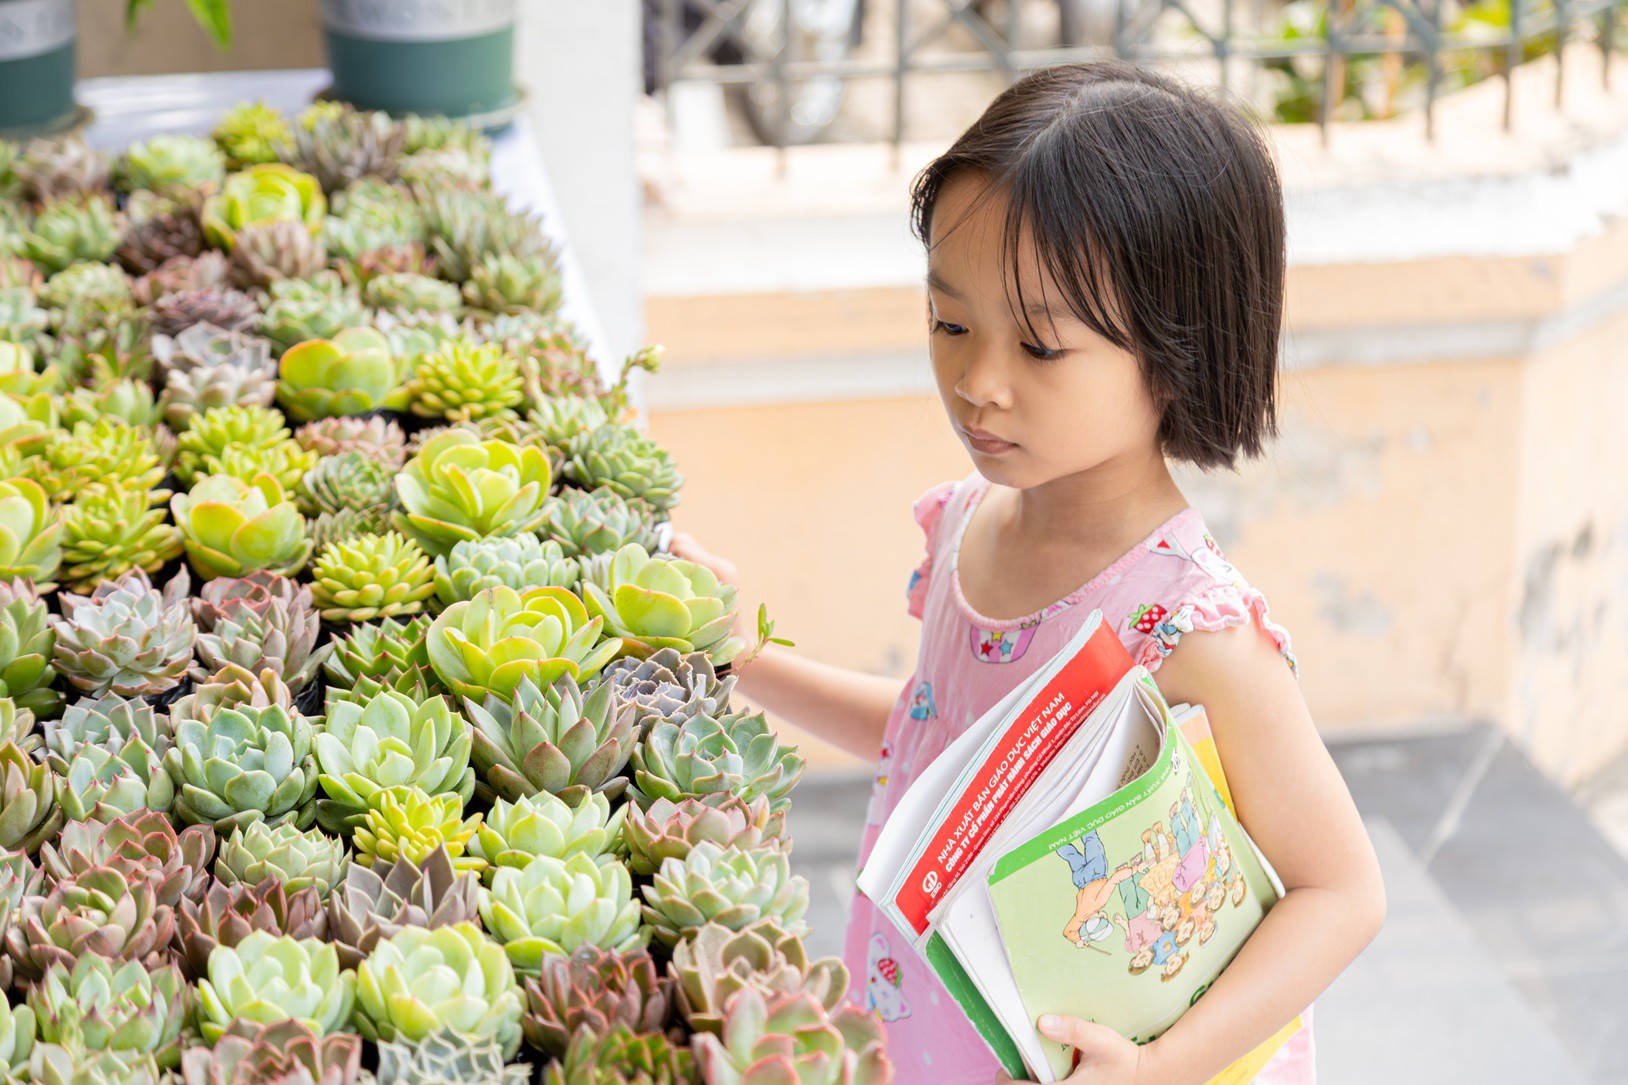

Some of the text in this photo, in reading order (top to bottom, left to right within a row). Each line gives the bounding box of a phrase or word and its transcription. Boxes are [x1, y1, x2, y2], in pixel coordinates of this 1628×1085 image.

[937, 838, 957, 864] NHÀ
[953, 808, 974, 839] XUẤT
[972, 786, 991, 812] BẢN
[989, 760, 1009, 789] GIÁO
[1006, 736, 1027, 763] DỤC
[1023, 715, 1043, 739] VIỆT
[1041, 692, 1065, 719] NAM
[945, 846, 964, 873] CÔNG
[960, 835, 971, 849] TY
[967, 820, 979, 839] CỔ
[975, 800, 995, 827] PHẦN
[991, 779, 1009, 804] PHÁT
[1006, 756, 1026, 783] HÀNH
[1023, 735, 1043, 761] SÁCH
[1039, 717, 1058, 739] GIÁO
[1055, 701, 1072, 721] DỤC
[1143, 778, 1163, 797] XUẤT
[1125, 793, 1142, 808] BẢN
[1105, 805, 1125, 819] GIÁO
[1086, 816, 1105, 830] DỤC
[1068, 827, 1087, 840] VIỆT
[1048, 836, 1067, 850] NAM
